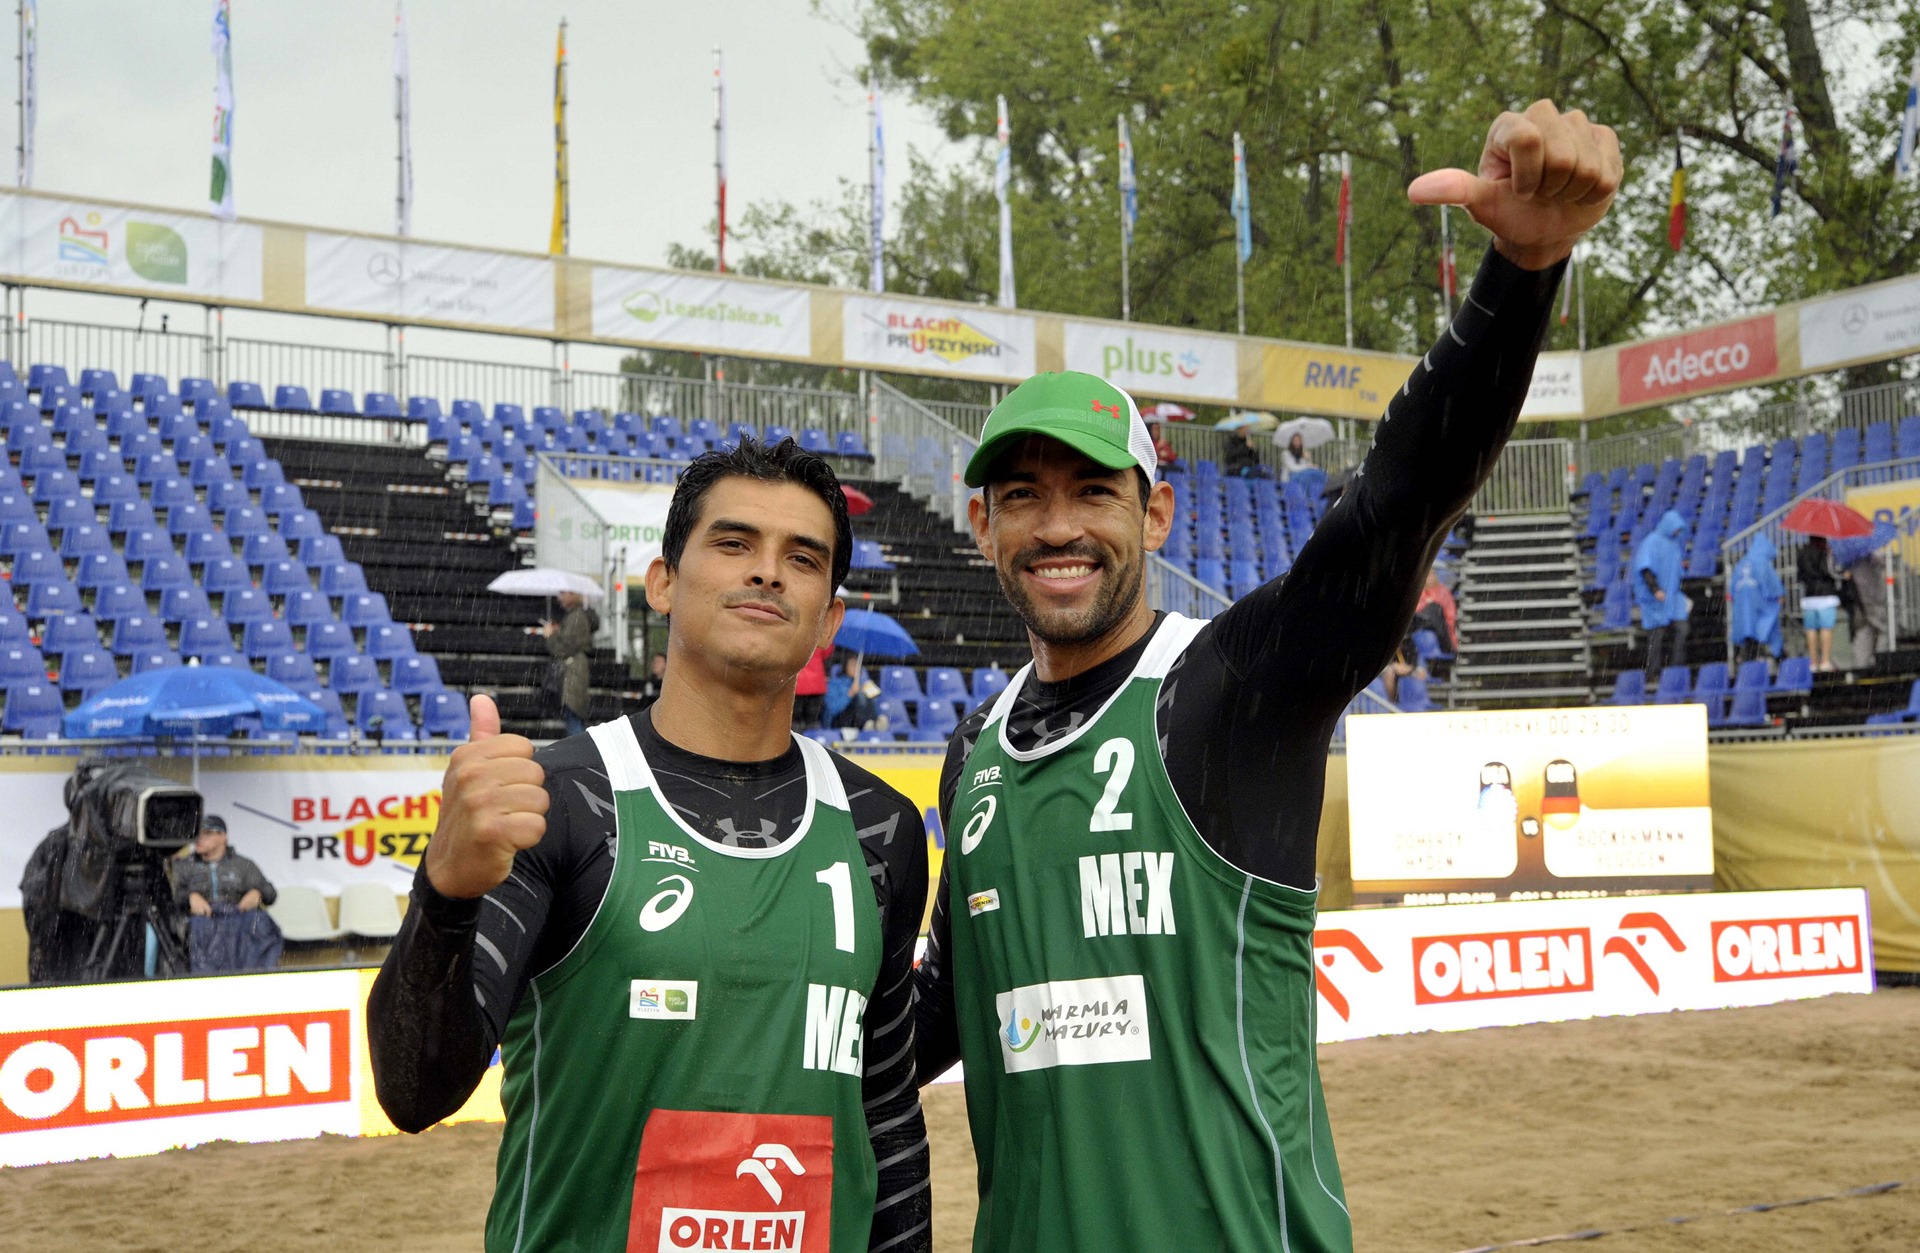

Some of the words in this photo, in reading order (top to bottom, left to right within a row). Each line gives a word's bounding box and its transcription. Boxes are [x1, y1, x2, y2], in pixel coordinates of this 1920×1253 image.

[886, 313, 962, 335] BLACHY
[1102, 336, 1175, 380] plus
[1303, 359, 1362, 390] RMF
[1643, 341, 1750, 389] Adecco
[972, 765, 1002, 787] FIVB
[1089, 737, 1135, 832] 2
[648, 840, 690, 863] FIVB
[814, 861, 856, 954] 1
[1079, 852, 1177, 939] MEX
[1417, 934, 1586, 998] ORLEN
[1716, 920, 1857, 977] ORLEN
[803, 983, 868, 1079] ME
[0, 1021, 332, 1120] ORLEN
[668, 1215, 798, 1252] ORLEN
